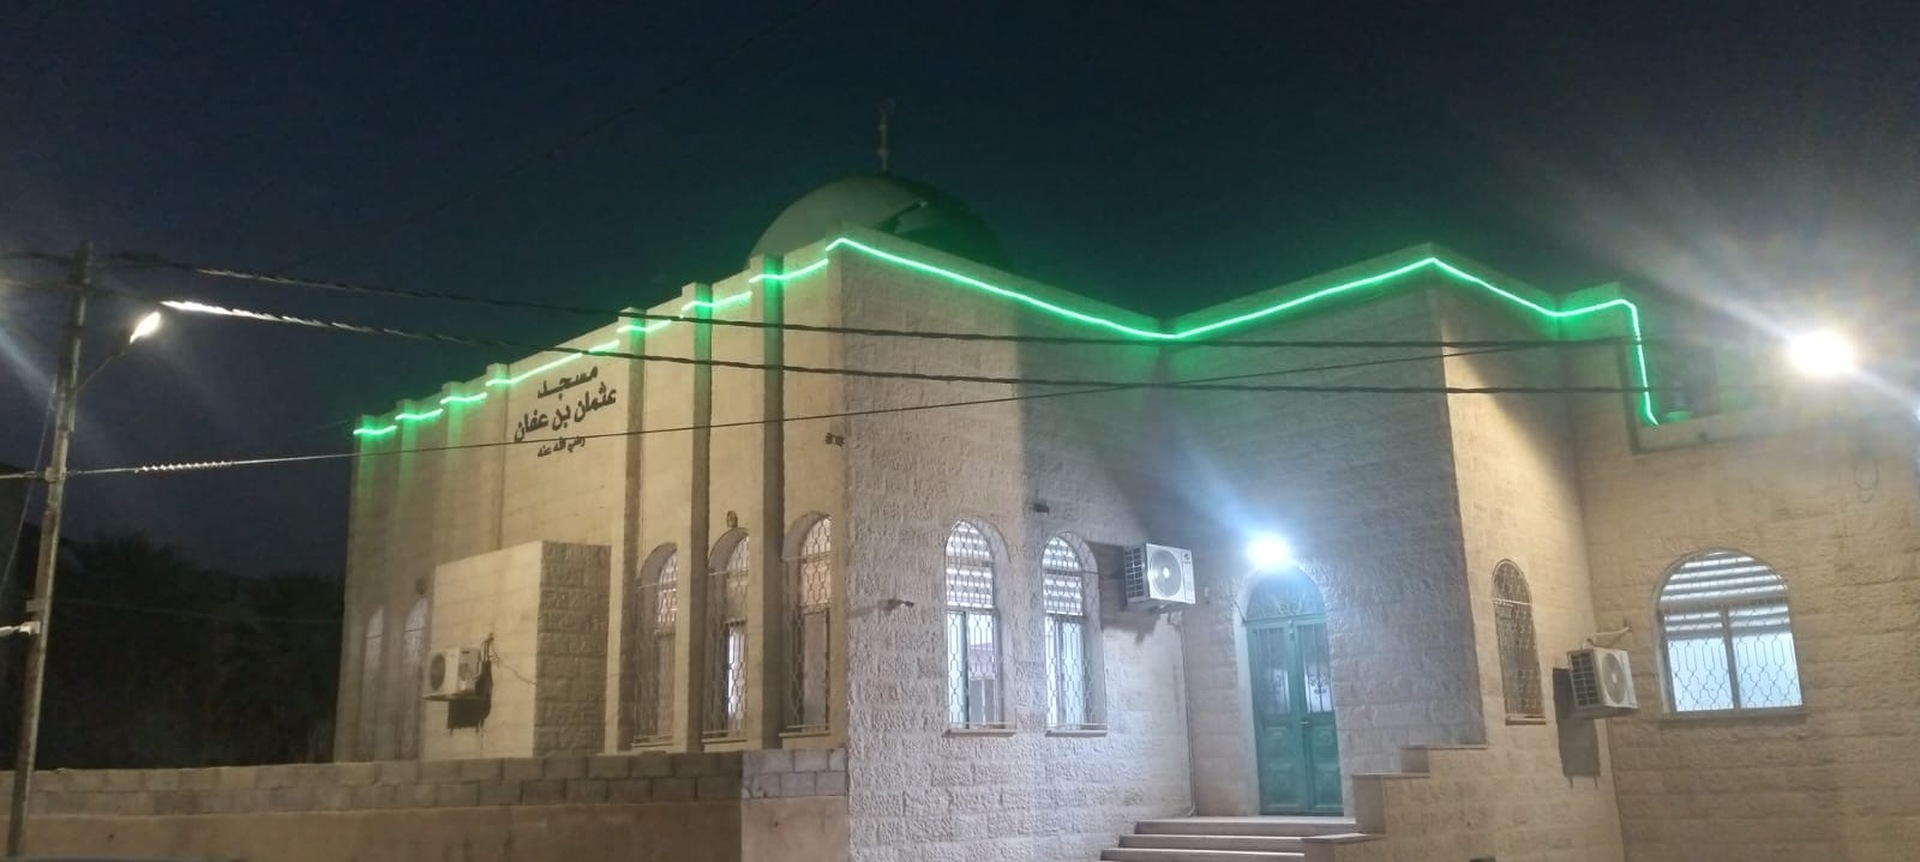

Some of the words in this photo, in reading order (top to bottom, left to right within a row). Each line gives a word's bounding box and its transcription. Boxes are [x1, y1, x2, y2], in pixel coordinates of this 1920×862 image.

[537, 366, 598, 400] مسجد
[574, 382, 617, 422] عثمان
[514, 409, 549, 443] عفان
[552, 404, 571, 431] بن
[537, 445, 552, 457] عنه
[553, 436, 566, 451] الله
[567, 435, 586, 453] رضي
